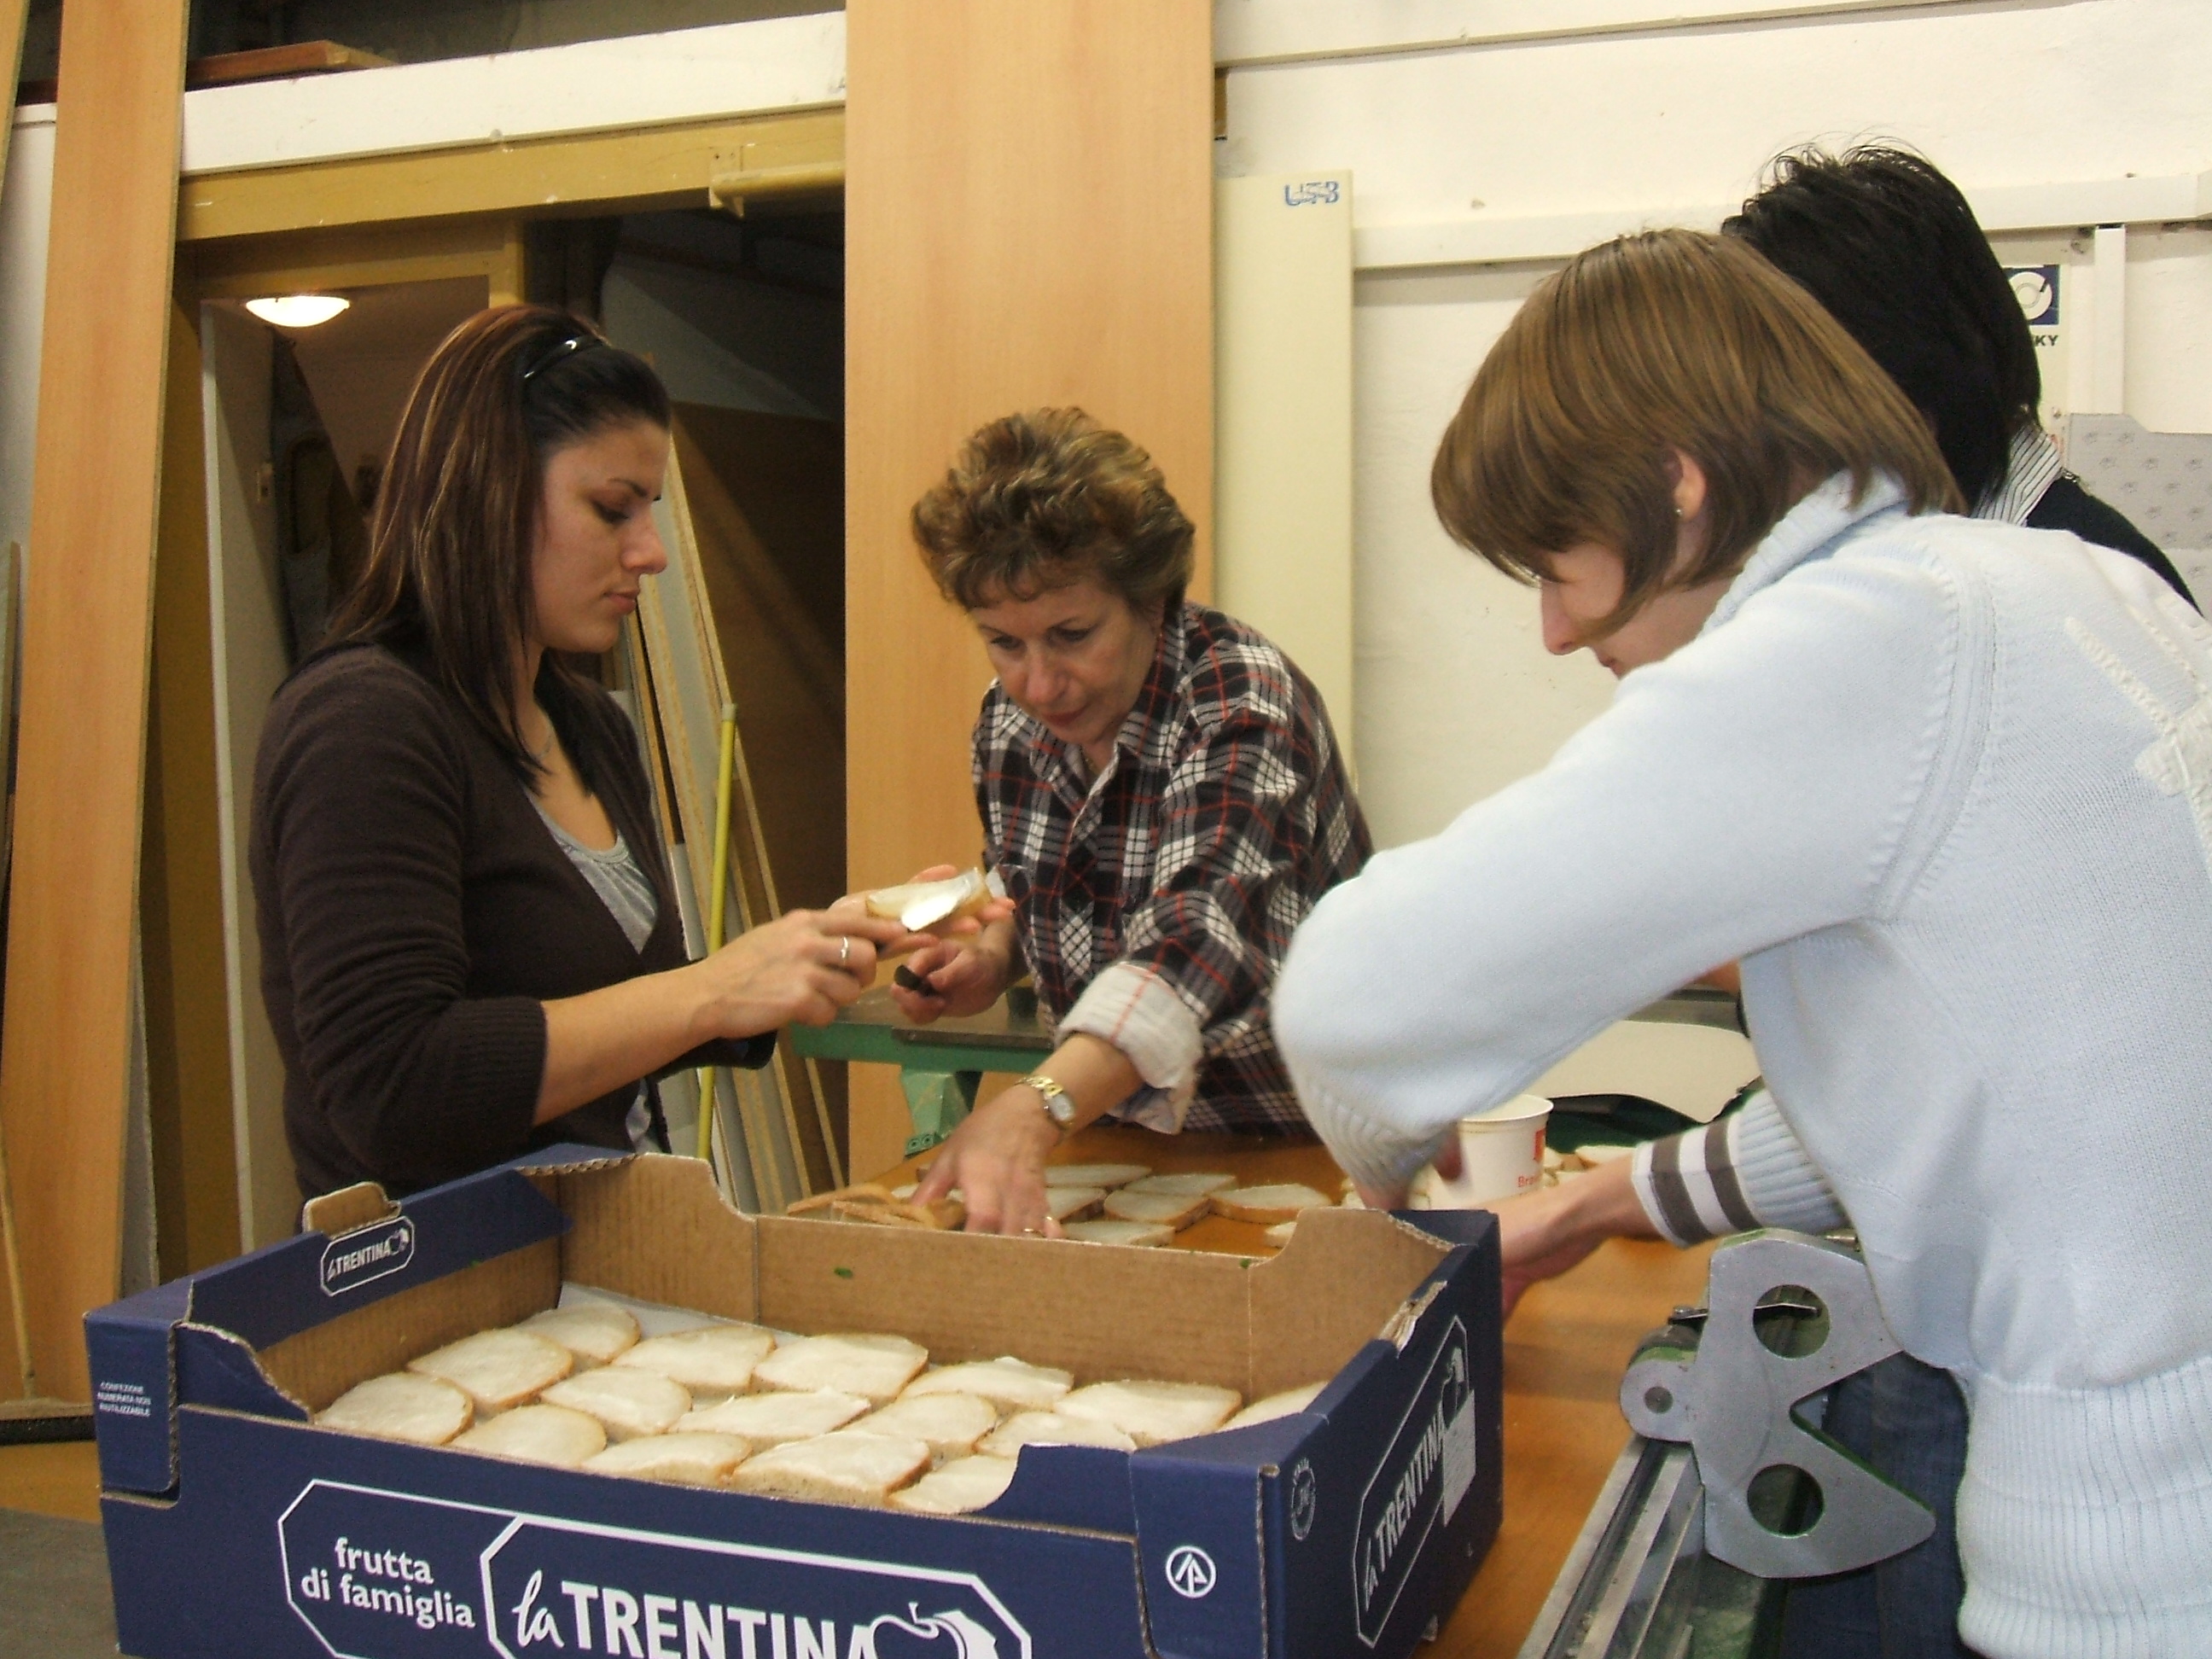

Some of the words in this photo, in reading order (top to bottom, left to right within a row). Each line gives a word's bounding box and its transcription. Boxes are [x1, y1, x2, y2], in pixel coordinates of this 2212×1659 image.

[336, 1240, 391, 1275] TRENTINA
[335, 1537, 434, 1585] frutta
[301, 1568, 330, 1601] di
[341, 1574, 475, 1630] famiglia
[512, 1570, 564, 1649] la
